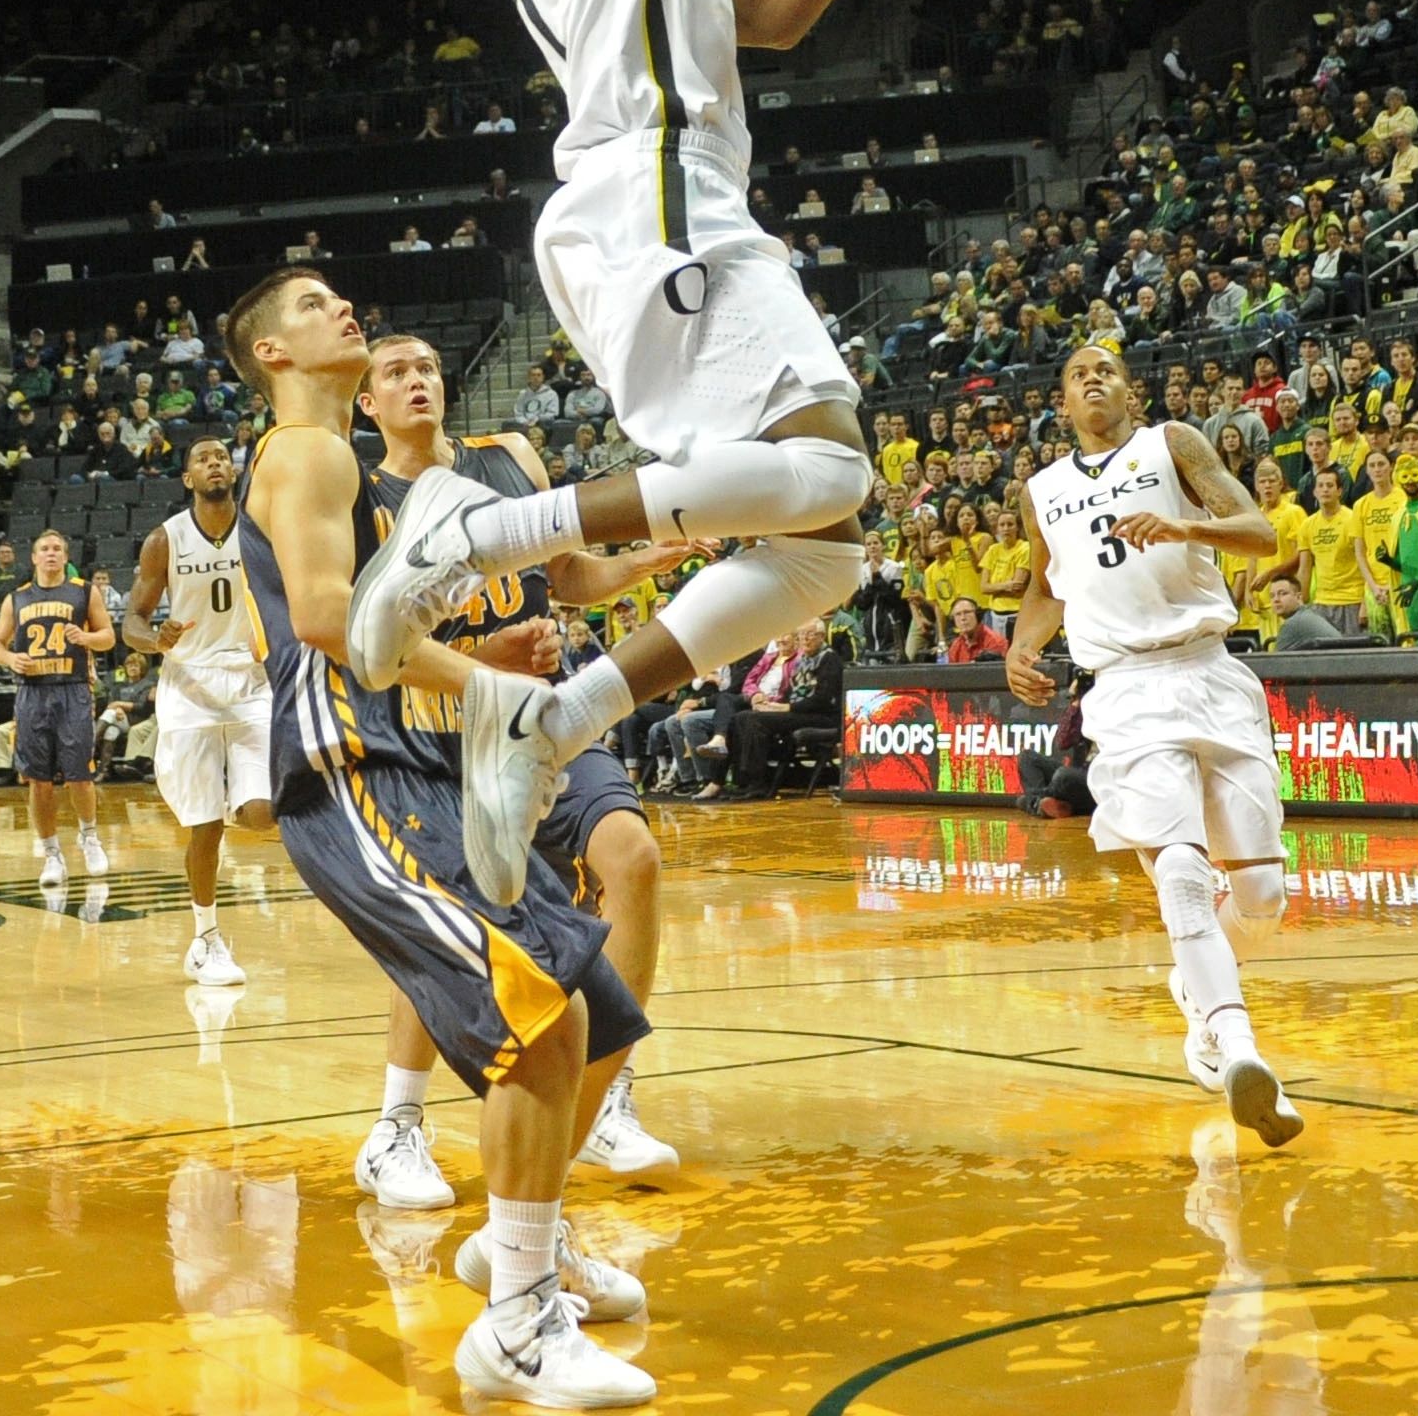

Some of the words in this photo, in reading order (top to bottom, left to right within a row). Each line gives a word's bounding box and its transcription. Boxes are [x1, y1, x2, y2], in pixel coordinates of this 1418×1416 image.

[1046, 472, 1161, 526] DUCKS
[1090, 513, 1127, 569] 3
[177, 558, 242, 577] DUCK
[211, 577, 232, 613] 0
[27, 621, 67, 658] 24
[860, 724, 936, 756] HOOPS
[955, 724, 1059, 757] HEALTHY
